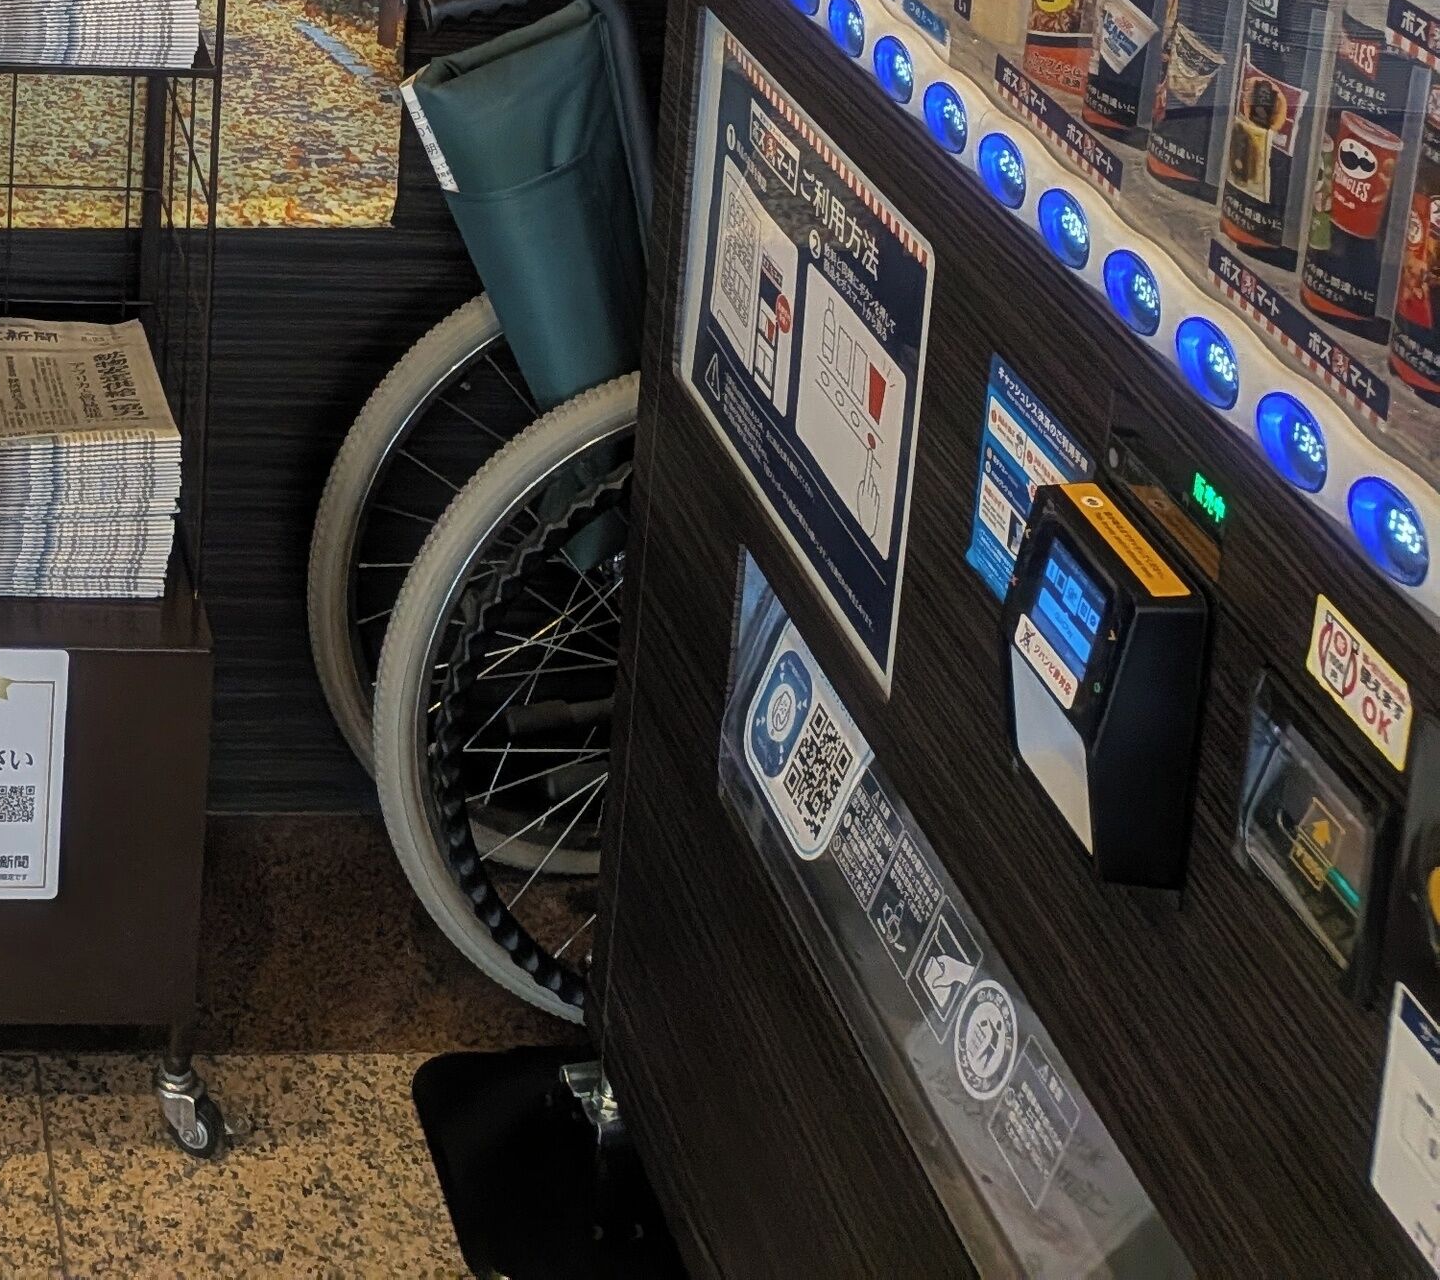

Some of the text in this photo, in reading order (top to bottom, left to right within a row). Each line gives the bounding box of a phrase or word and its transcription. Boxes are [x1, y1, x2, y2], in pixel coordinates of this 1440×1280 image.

[1065, 123, 1115, 176] ボスマート
[800, 168, 880, 282] ご利用方法
[1219, 255, 1281, 317] ボスマート
[1308, 331, 1377, 399] ボスマート
[1208, 342, 1236, 382] 150
[1293, 421, 1323, 463] 130
[1387, 508, 1421, 555] 130
[1361, 695, 1393, 745] OK
